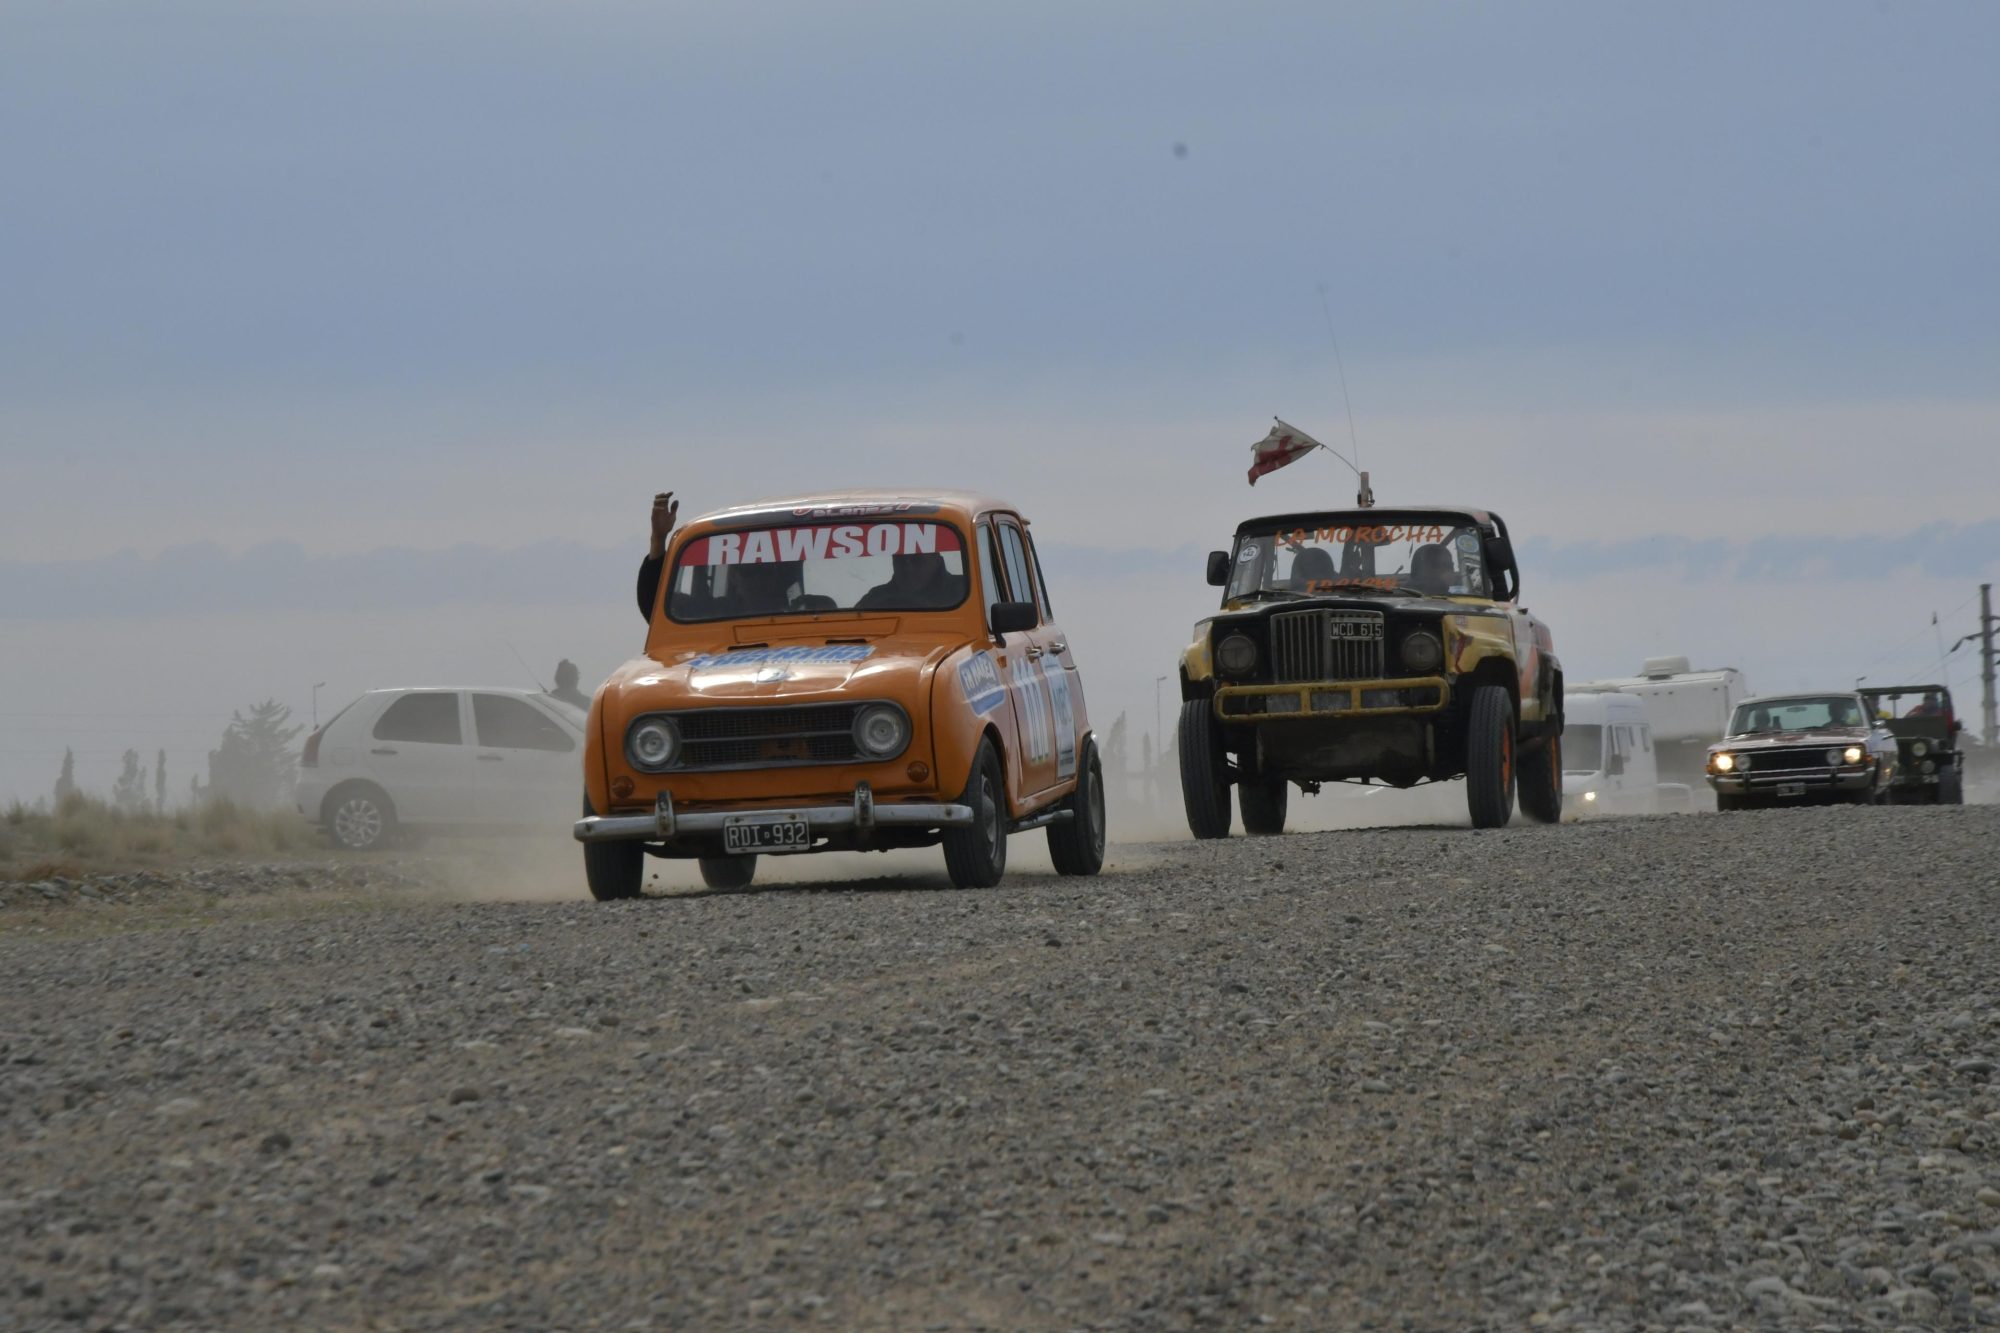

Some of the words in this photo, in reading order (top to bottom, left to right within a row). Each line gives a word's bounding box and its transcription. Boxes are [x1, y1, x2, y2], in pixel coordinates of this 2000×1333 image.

[707, 523, 938, 565] RAWSON
[1275, 528, 1308, 546] LA
[1314, 525, 1444, 545] MOROCHA
[1360, 624, 1382, 637] 615
[728, 826, 761, 847] RDI
[772, 822, 806, 844] 932
